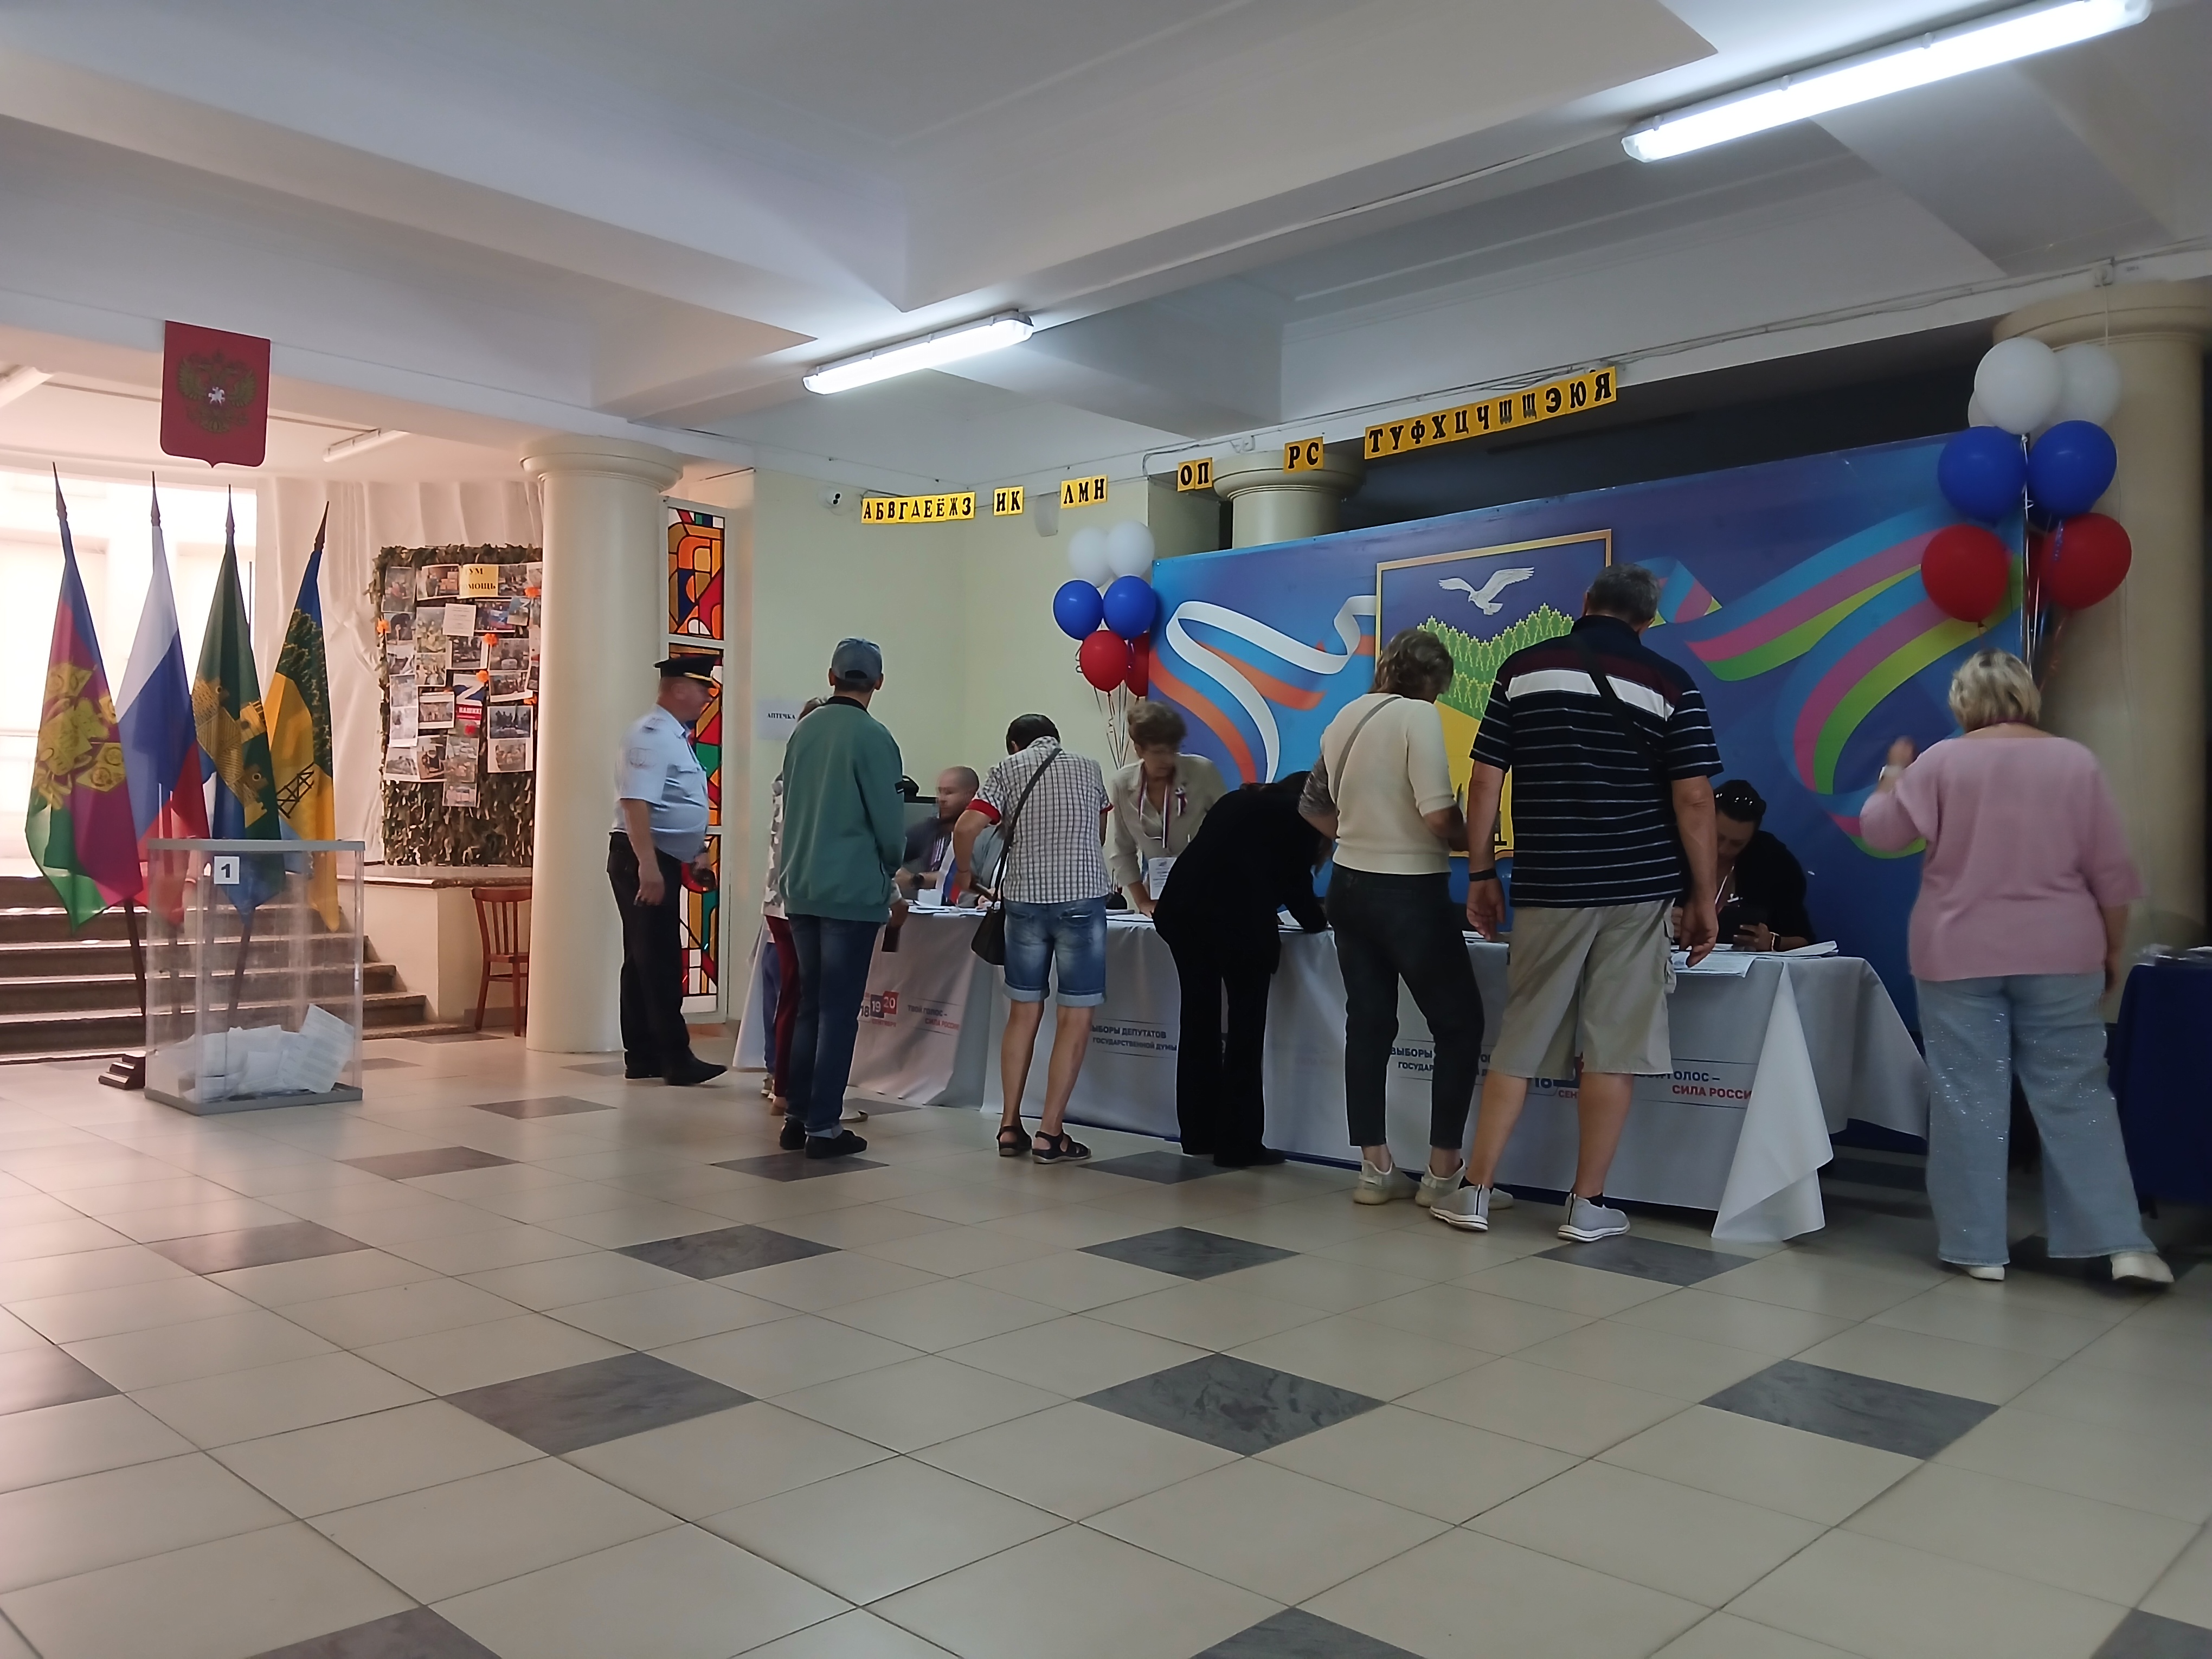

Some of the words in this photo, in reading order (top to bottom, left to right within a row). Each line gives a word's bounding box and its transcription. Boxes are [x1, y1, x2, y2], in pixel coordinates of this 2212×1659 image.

[1369, 372, 1611, 453] ТУФХЦЧШЩЭЮЯ
[1288, 431, 1320, 469] РС
[1180, 462, 1210, 486] ОП
[1063, 478, 1105, 504] ЛМН
[863, 497, 972, 520] АБВГДЕЁЖЗ
[996, 490, 1020, 512] ИК
[221, 863, 230, 878] 1
[872, 1001, 881, 1013] 19
[884, 996, 896, 1009] 20
[1091, 1024, 1121, 1034] ЫБОРЫ
[1121, 1027, 1167, 1039] ДЕПУТАТОВ
[1155, 1043, 1177, 1051] ДУМЫ
[1391, 1046, 1433, 1059] ВЫБОРЫ
[1398, 1061, 1434, 1071] ГОСУДАР
[1672, 1084, 1706, 1096] СИЛА
[1709, 1088, 1752, 1099] РОССИ
